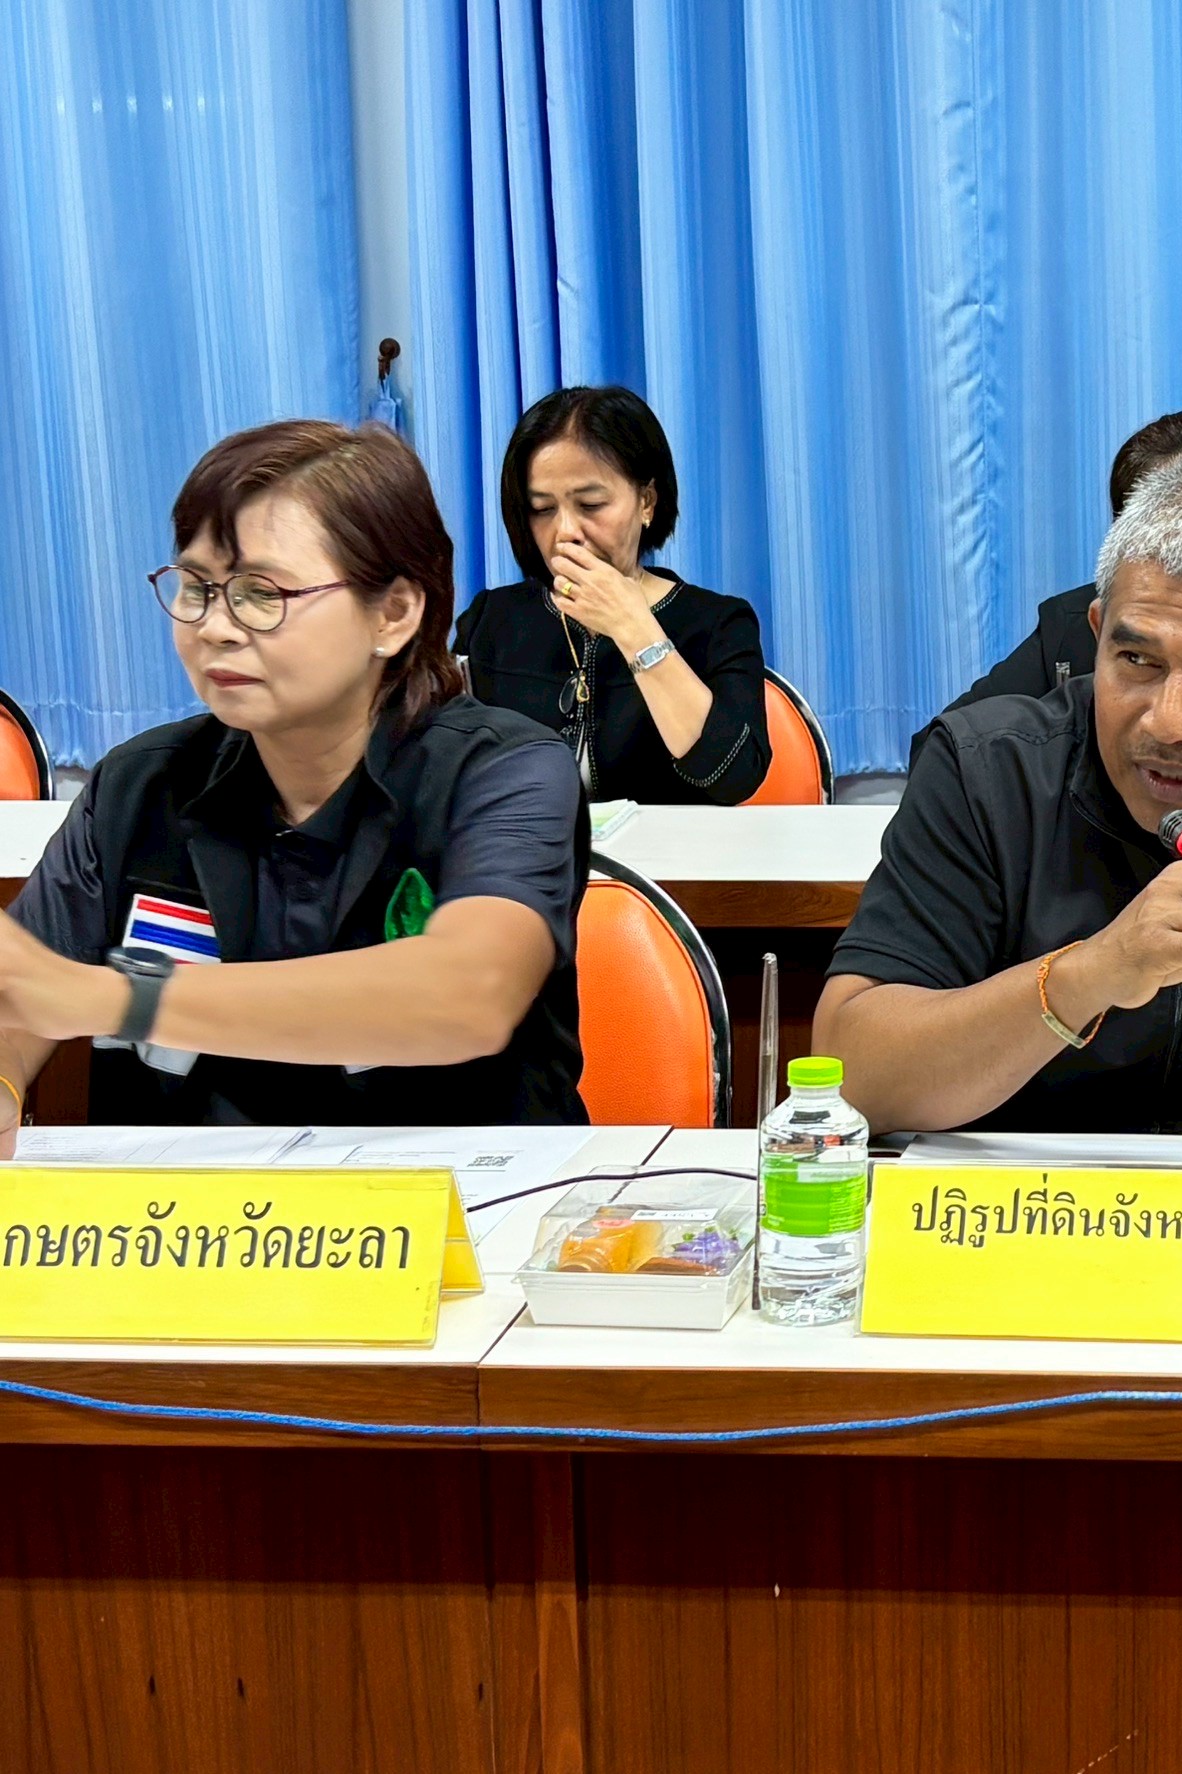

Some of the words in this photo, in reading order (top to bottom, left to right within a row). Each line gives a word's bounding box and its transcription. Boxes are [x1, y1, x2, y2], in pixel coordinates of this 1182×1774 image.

[2, 1200, 411, 1269] กษตรจังหวัดยะลา
